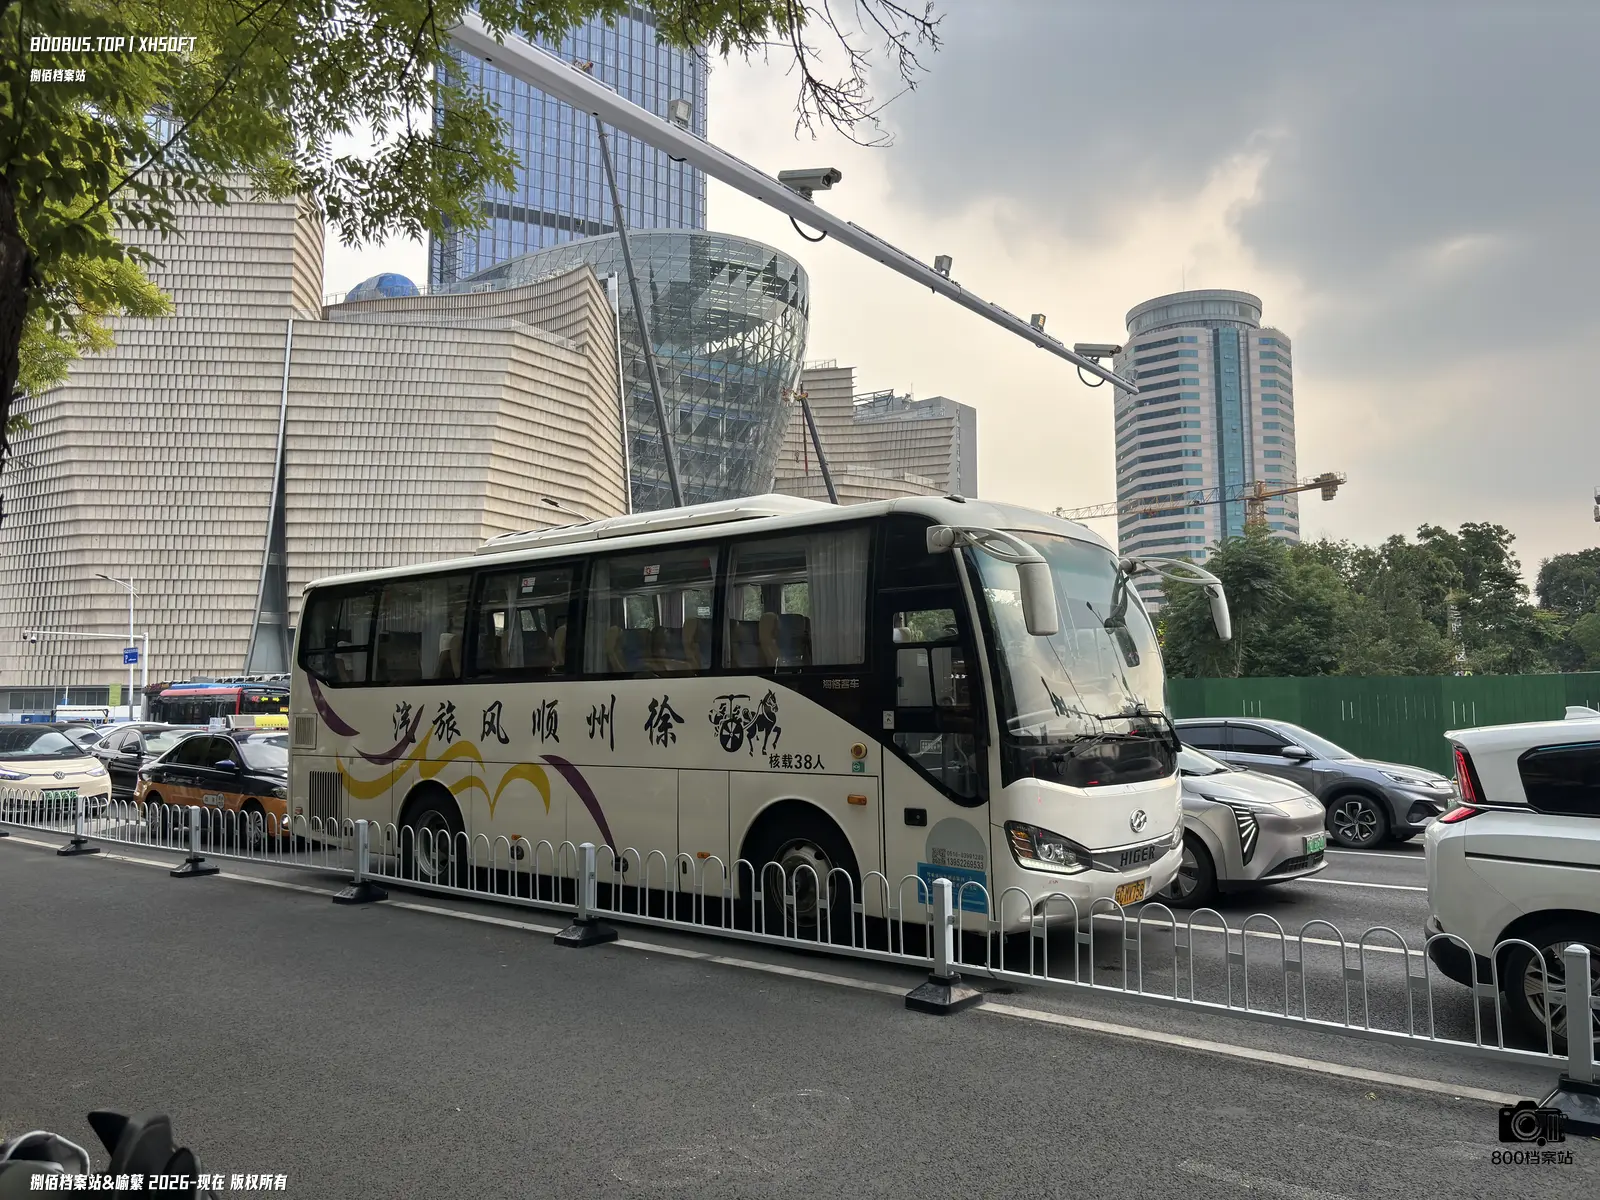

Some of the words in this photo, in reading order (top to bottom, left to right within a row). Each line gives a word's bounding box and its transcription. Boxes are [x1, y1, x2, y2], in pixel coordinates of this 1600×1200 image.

[768, 753, 825, 770] 核载38人
[1119, 844, 1156, 867] HIGER
